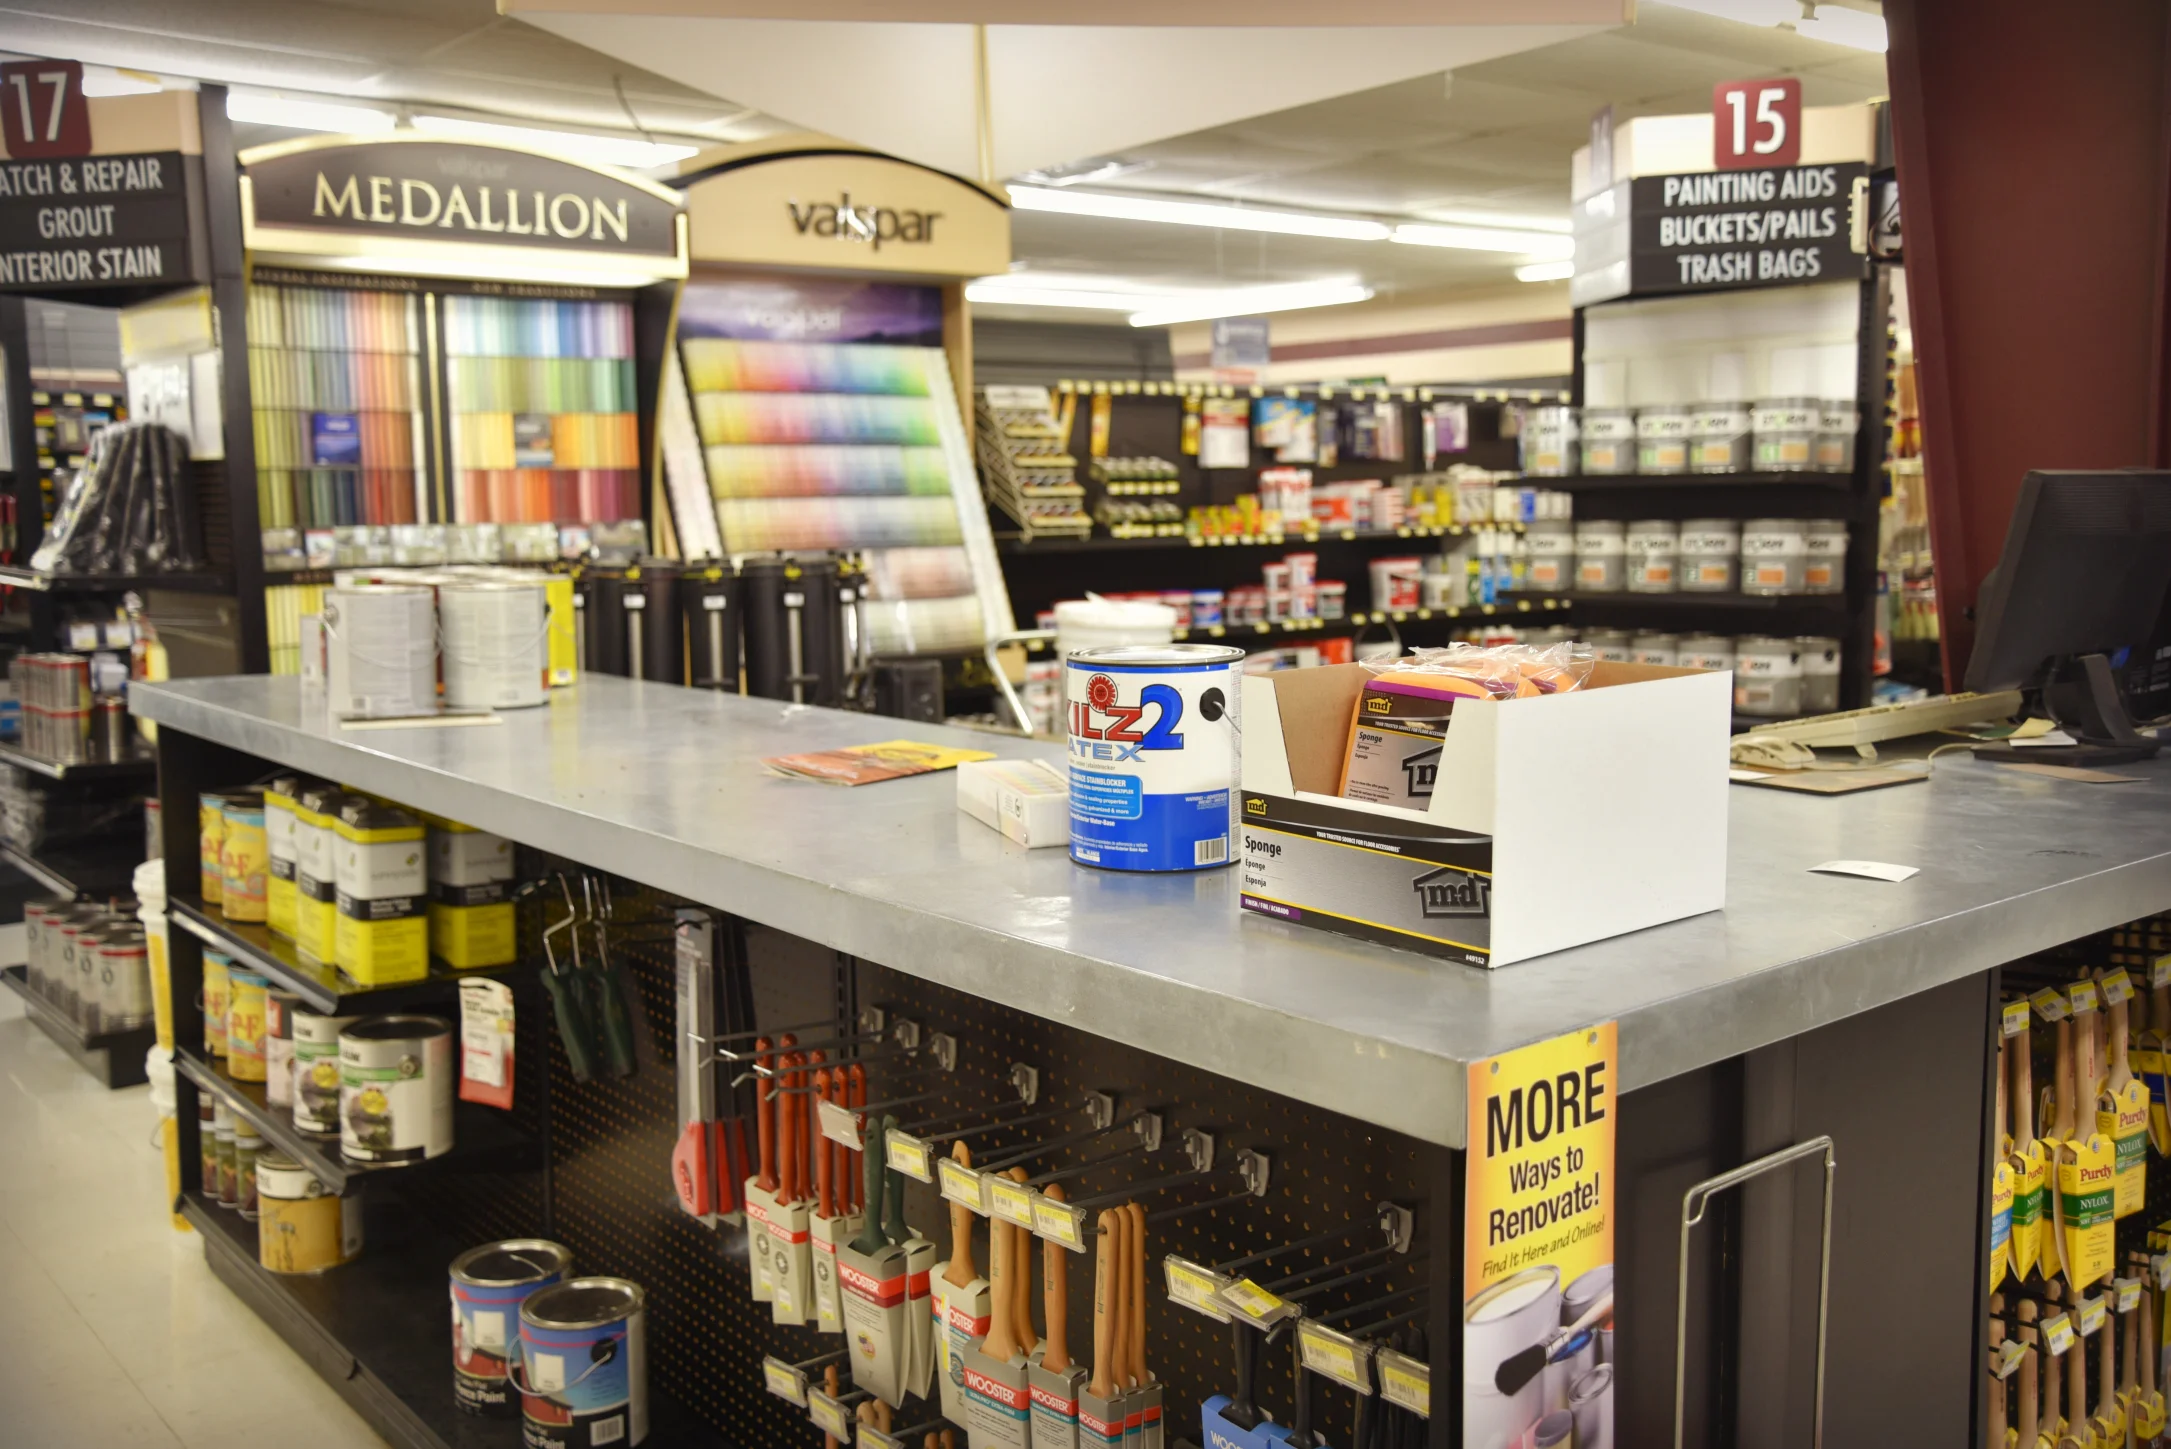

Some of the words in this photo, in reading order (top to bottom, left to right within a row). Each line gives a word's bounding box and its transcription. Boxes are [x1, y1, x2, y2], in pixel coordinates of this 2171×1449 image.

[10, 71, 67, 142] 17
[1725, 88, 1787, 156] 15
[0, 164, 54, 196] ATCH
[60, 162, 78, 194] &
[82, 158, 164, 193] REPAIR
[1663, 171, 1775, 208] PAINTING
[1780, 167, 1838, 201] AIDS
[38, 205, 115, 239] GROUT
[312, 170, 629, 243] MEDALLION
[787, 188, 945, 251] valspar
[1660, 208, 1838, 247] BUCKETS/PAILS
[0, 250, 94, 284] NTERIOR
[98, 245, 164, 280] STAIN
[1677, 251, 1751, 285] TRASH
[1758, 247, 1823, 280] BAGS
[1134, 683, 1184, 750] 2
[1068, 737, 1146, 762] ATEX
[1359, 731, 1382, 743] Sponge
[1087, 775, 1127, 787] STAINBLOCKER
[1245, 835, 1282, 857] Sponge
[1326, 832, 1342, 842] TRUSTED
[1245, 874, 1267, 887] Esponja
[1487, 1060, 1606, 1158] MORE
[2119, 1107, 2147, 1128] Purdy
[2116, 1138, 2142, 1154] NYLOX
[1509, 1155, 1561, 1194] Ways
[1566, 1145, 1584, 1174] to
[2027, 1163, 2044, 1182] Purdy
[2080, 1164, 2113, 1182] Purdy
[1489, 1171, 1599, 1247] Renovate!
[2080, 1195, 2110, 1210] NYLOX
[1482, 1253, 1508, 1279] Find
[1509, 1252, 1519, 1269] It
[1522, 1245, 1548, 1263] Here
[1550, 1230, 1570, 1253] and
[1571, 1213, 1605, 1243] Online!
[839, 1263, 880, 1295] WOOSTER
[934, 1299, 975, 1333] WOSTER
[476, 1389, 506, 1403] Paint
[966, 1371, 1016, 1404] WOOSTER
[1031, 1386, 1069, 1413] WOOSTER
[1079, 1411, 1106, 1433] WOOSTER
